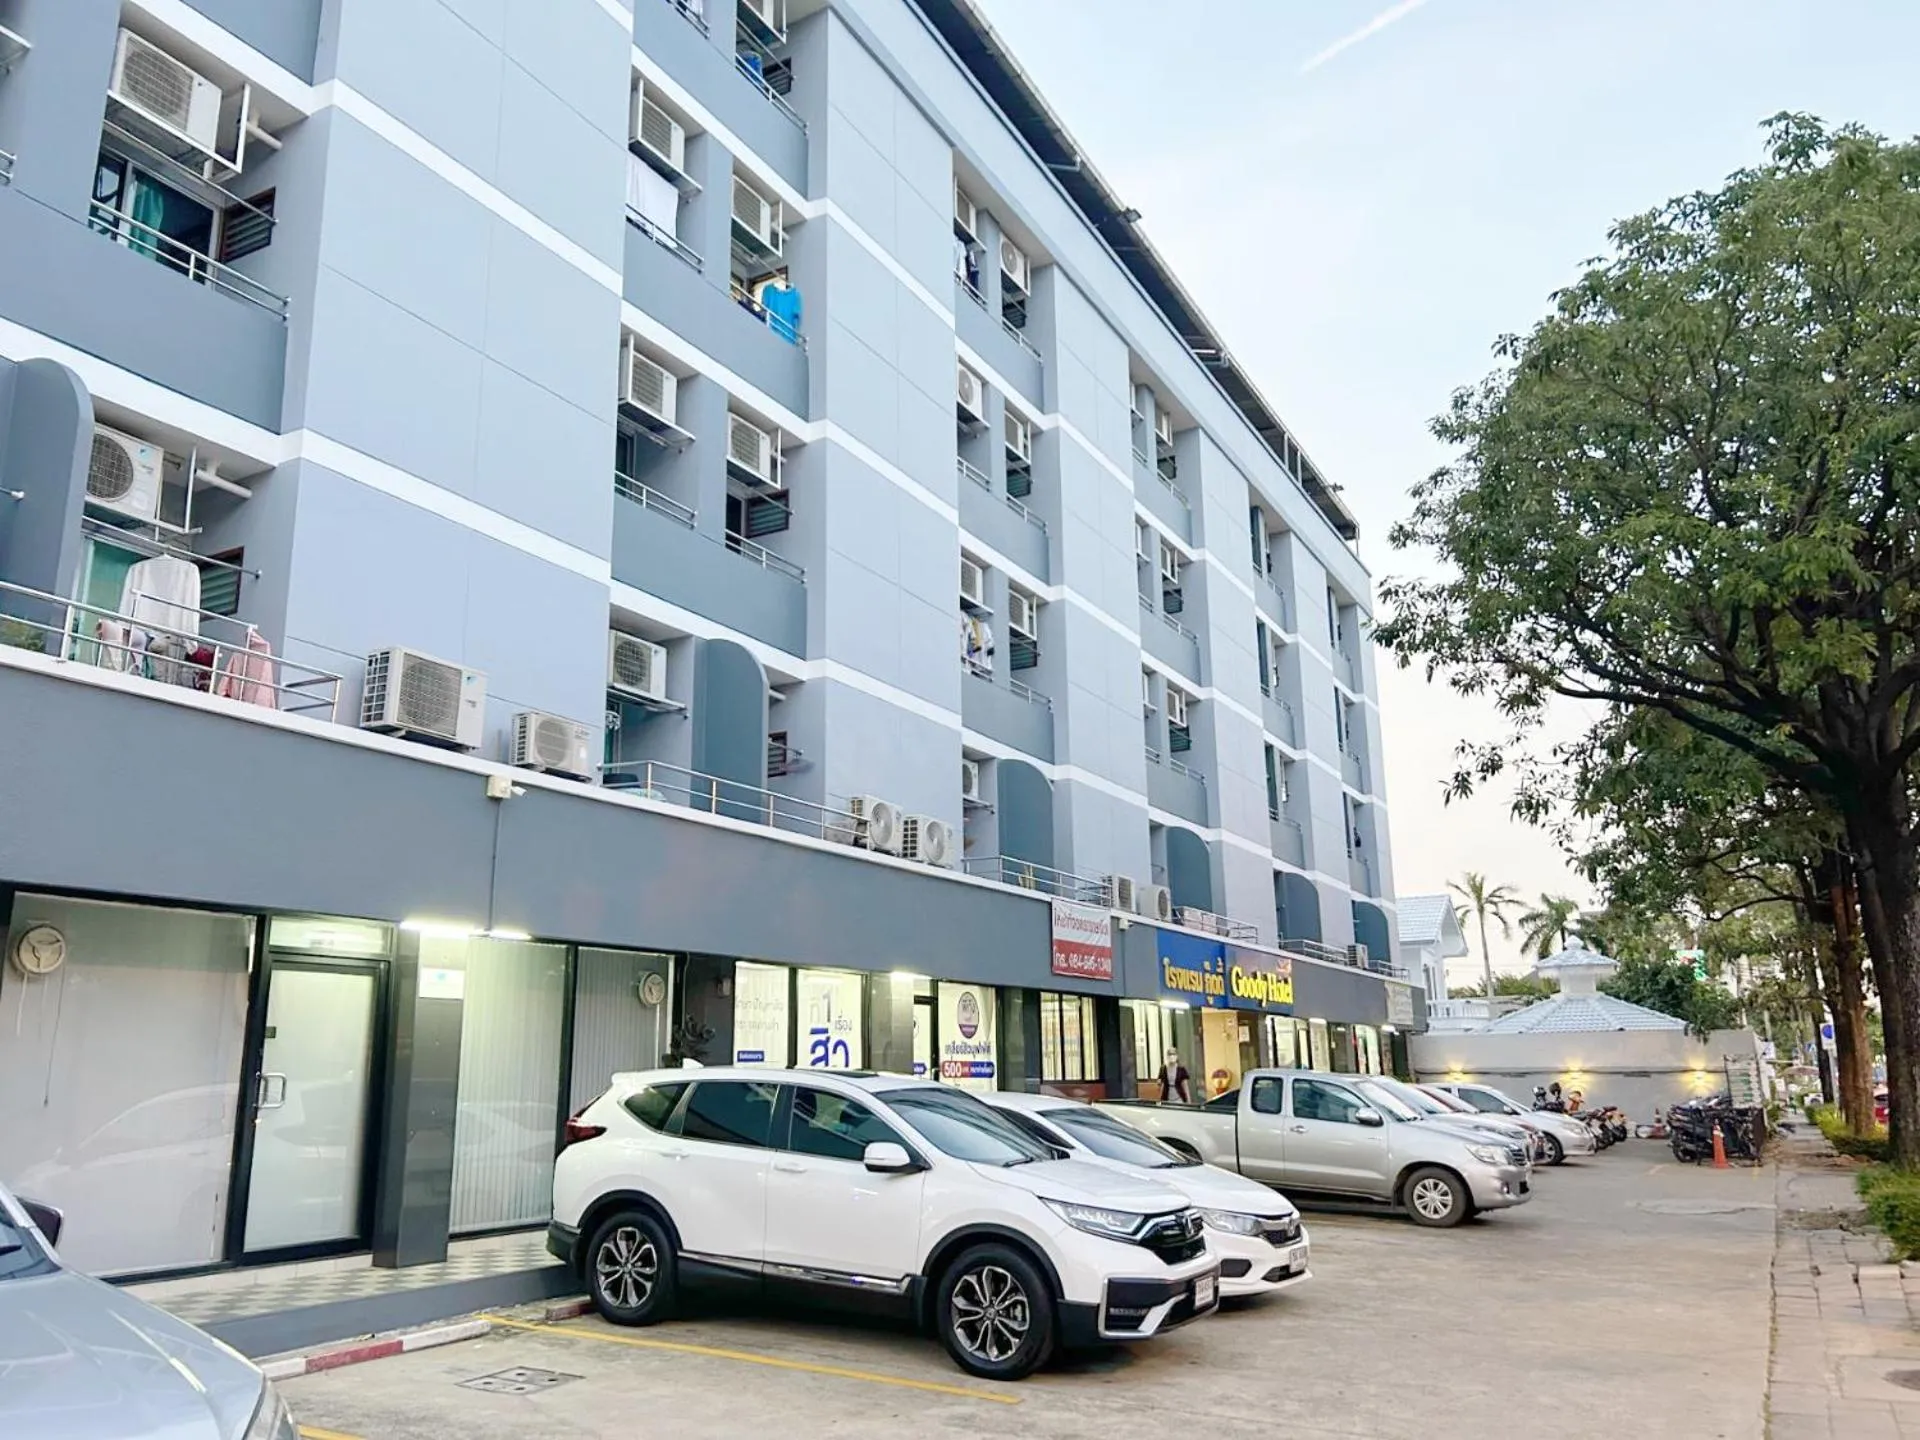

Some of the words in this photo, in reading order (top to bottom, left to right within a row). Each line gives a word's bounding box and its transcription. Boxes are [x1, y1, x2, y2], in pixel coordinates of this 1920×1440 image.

[1163, 957, 1203, 993] โรงแรม
[1231, 966, 1268, 1008] Goody
[1267, 972, 1294, 1005] Hotel
[943, 1062, 962, 1077] 500
